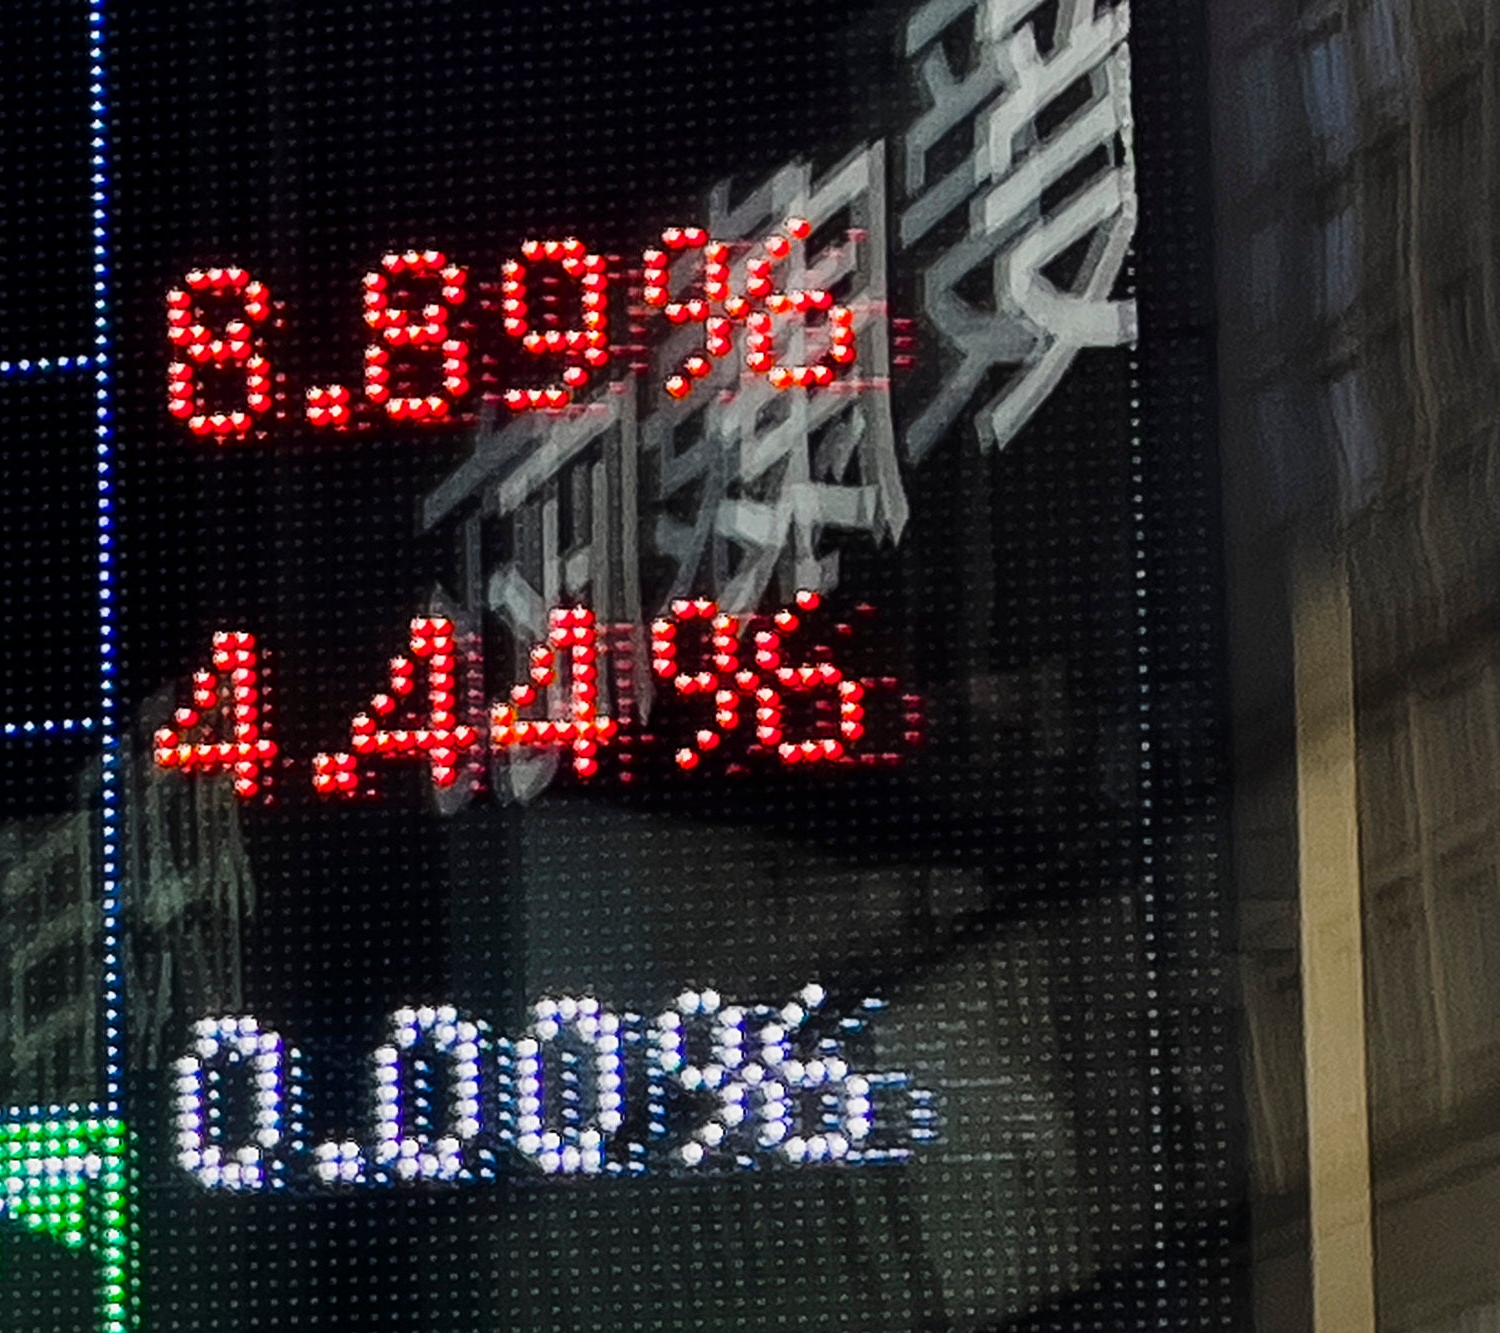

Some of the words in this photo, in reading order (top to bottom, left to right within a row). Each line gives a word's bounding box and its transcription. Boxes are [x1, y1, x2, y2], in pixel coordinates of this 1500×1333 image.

[165, 215, 854, 440] 8.89%
[152, 589, 866, 798] 4.44%
[172, 983, 872, 1190] 0.00%
